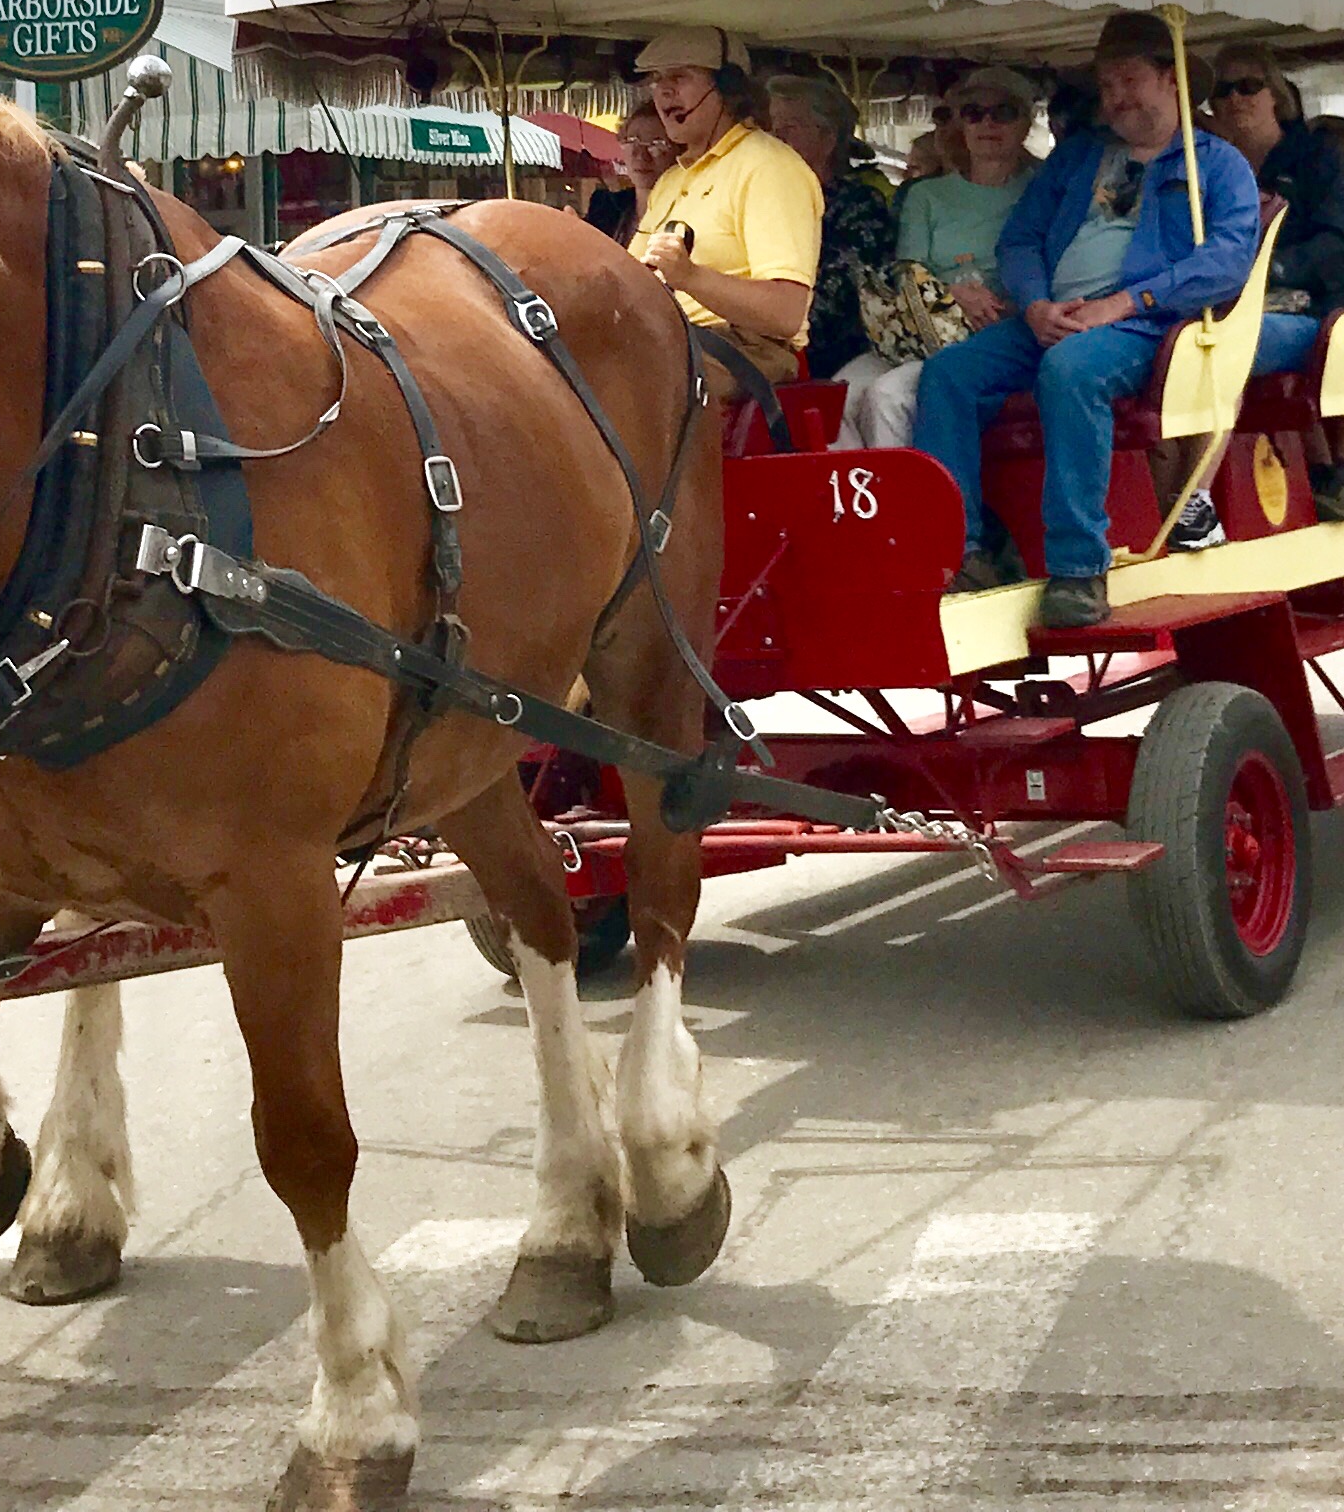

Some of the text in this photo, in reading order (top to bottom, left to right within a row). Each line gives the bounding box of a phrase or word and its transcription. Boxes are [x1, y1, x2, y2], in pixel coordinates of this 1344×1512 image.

[13, 19, 97, 57] GIFTS
[449, 129, 471, 146] Mine
[828, 467, 878, 523] 18
